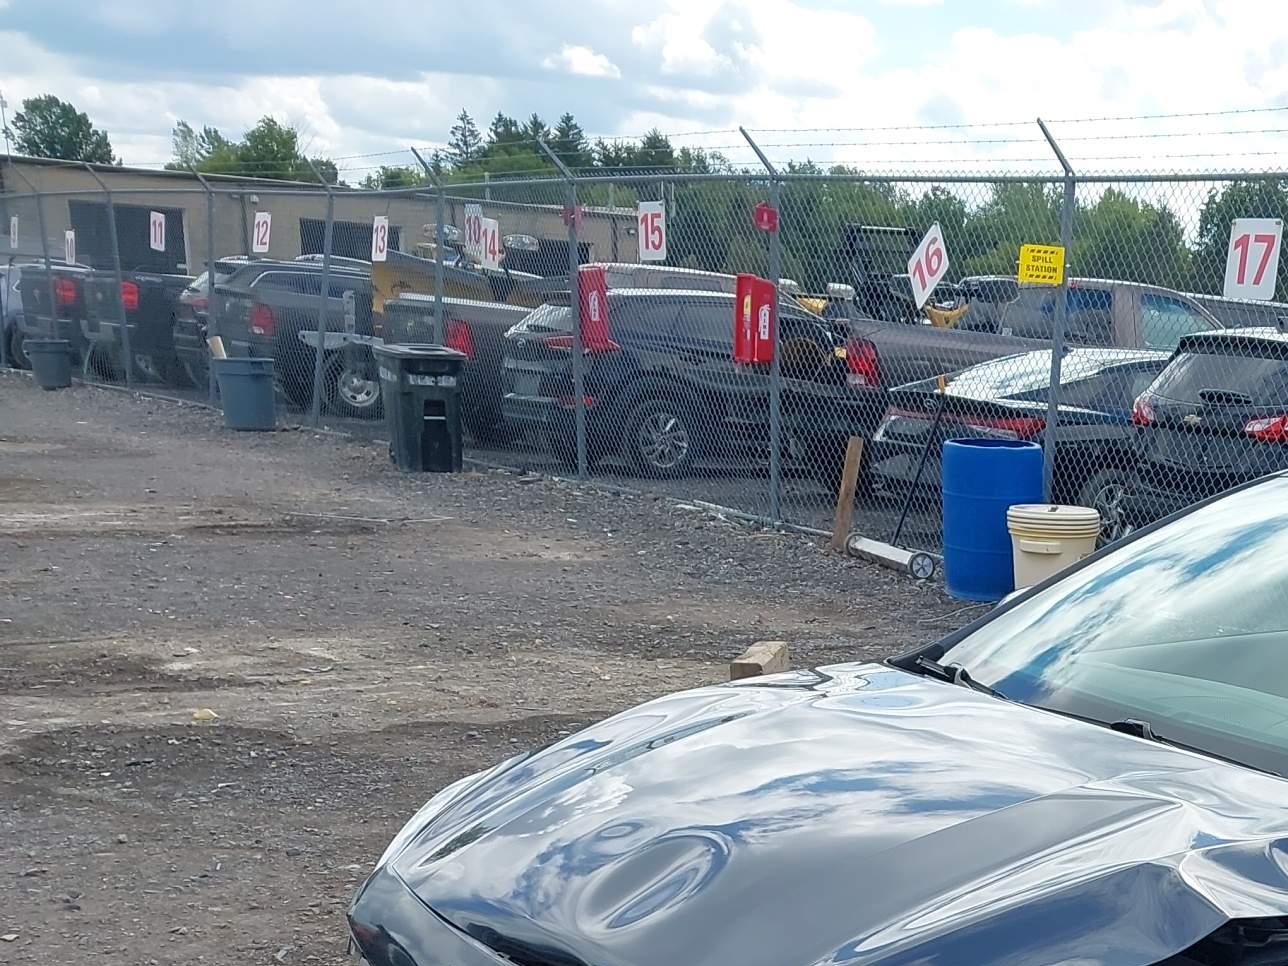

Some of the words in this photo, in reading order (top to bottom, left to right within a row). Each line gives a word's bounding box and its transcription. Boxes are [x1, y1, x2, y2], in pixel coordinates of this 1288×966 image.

[152, 219, 163, 245] 11
[255, 220, 269, 246] 12
[374, 224, 387, 254] 13
[482, 227, 498, 261] 14
[640, 212, 663, 251] 15
[912, 236, 943, 293] 16
[1025, 264, 1058, 274] STATION
[1031, 255, 1053, 264] SPILL
[1233, 234, 1276, 286] 17
